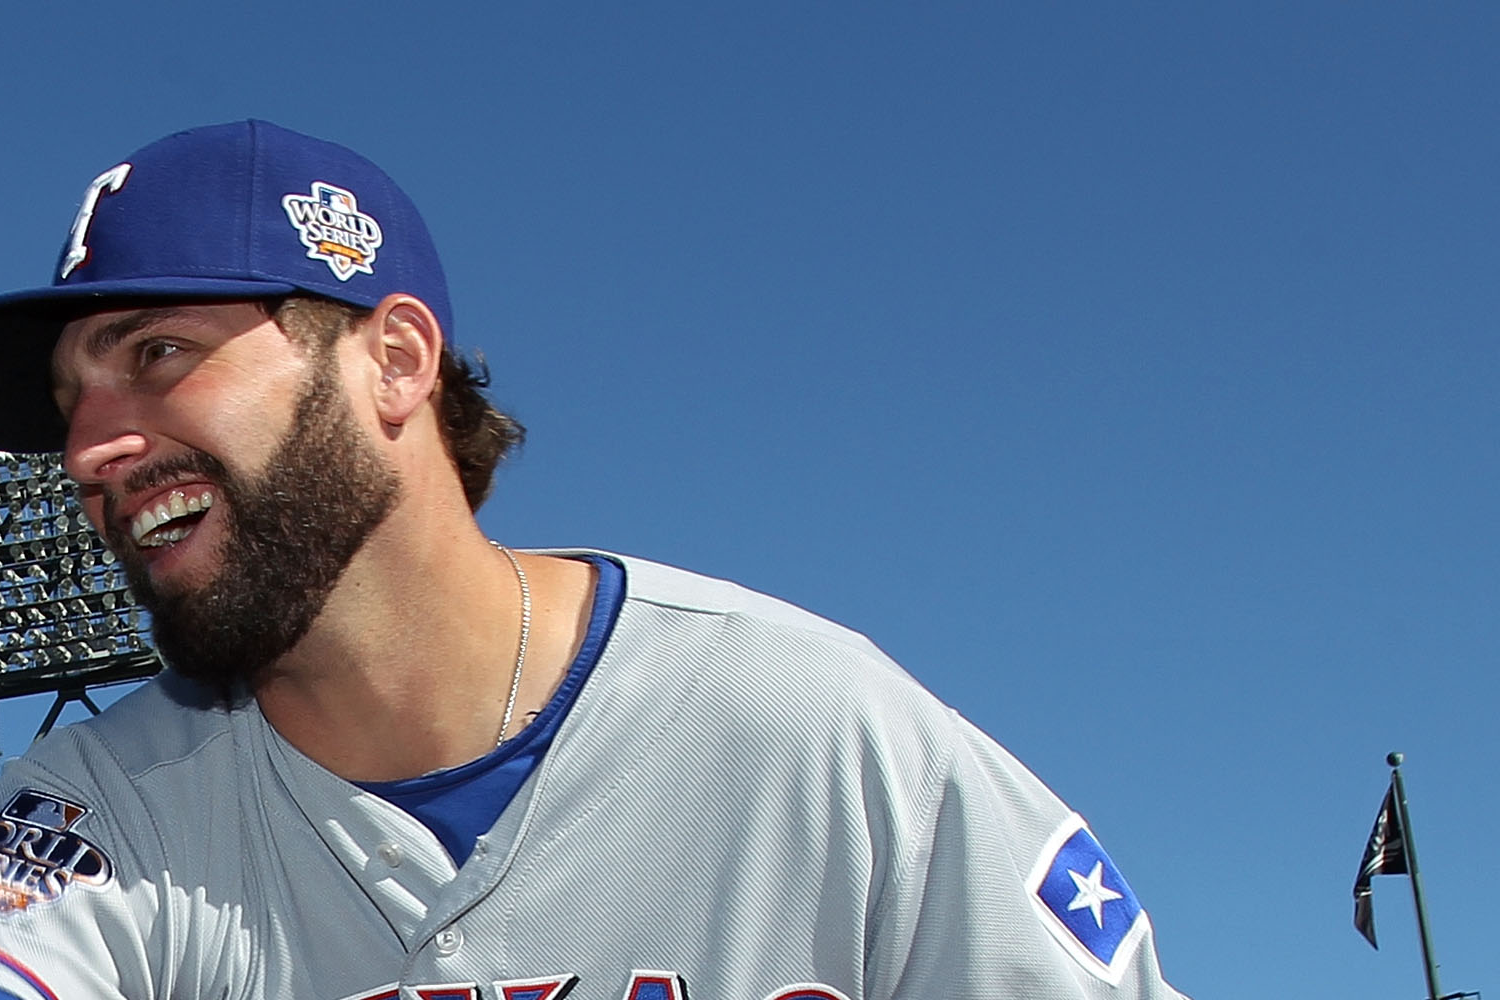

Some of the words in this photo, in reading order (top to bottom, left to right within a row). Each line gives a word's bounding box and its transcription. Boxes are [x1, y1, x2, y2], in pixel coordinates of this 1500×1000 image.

[61, 162, 132, 279] T
[288, 199, 380, 241] WORLD
[306, 220, 373, 257] SERIES
